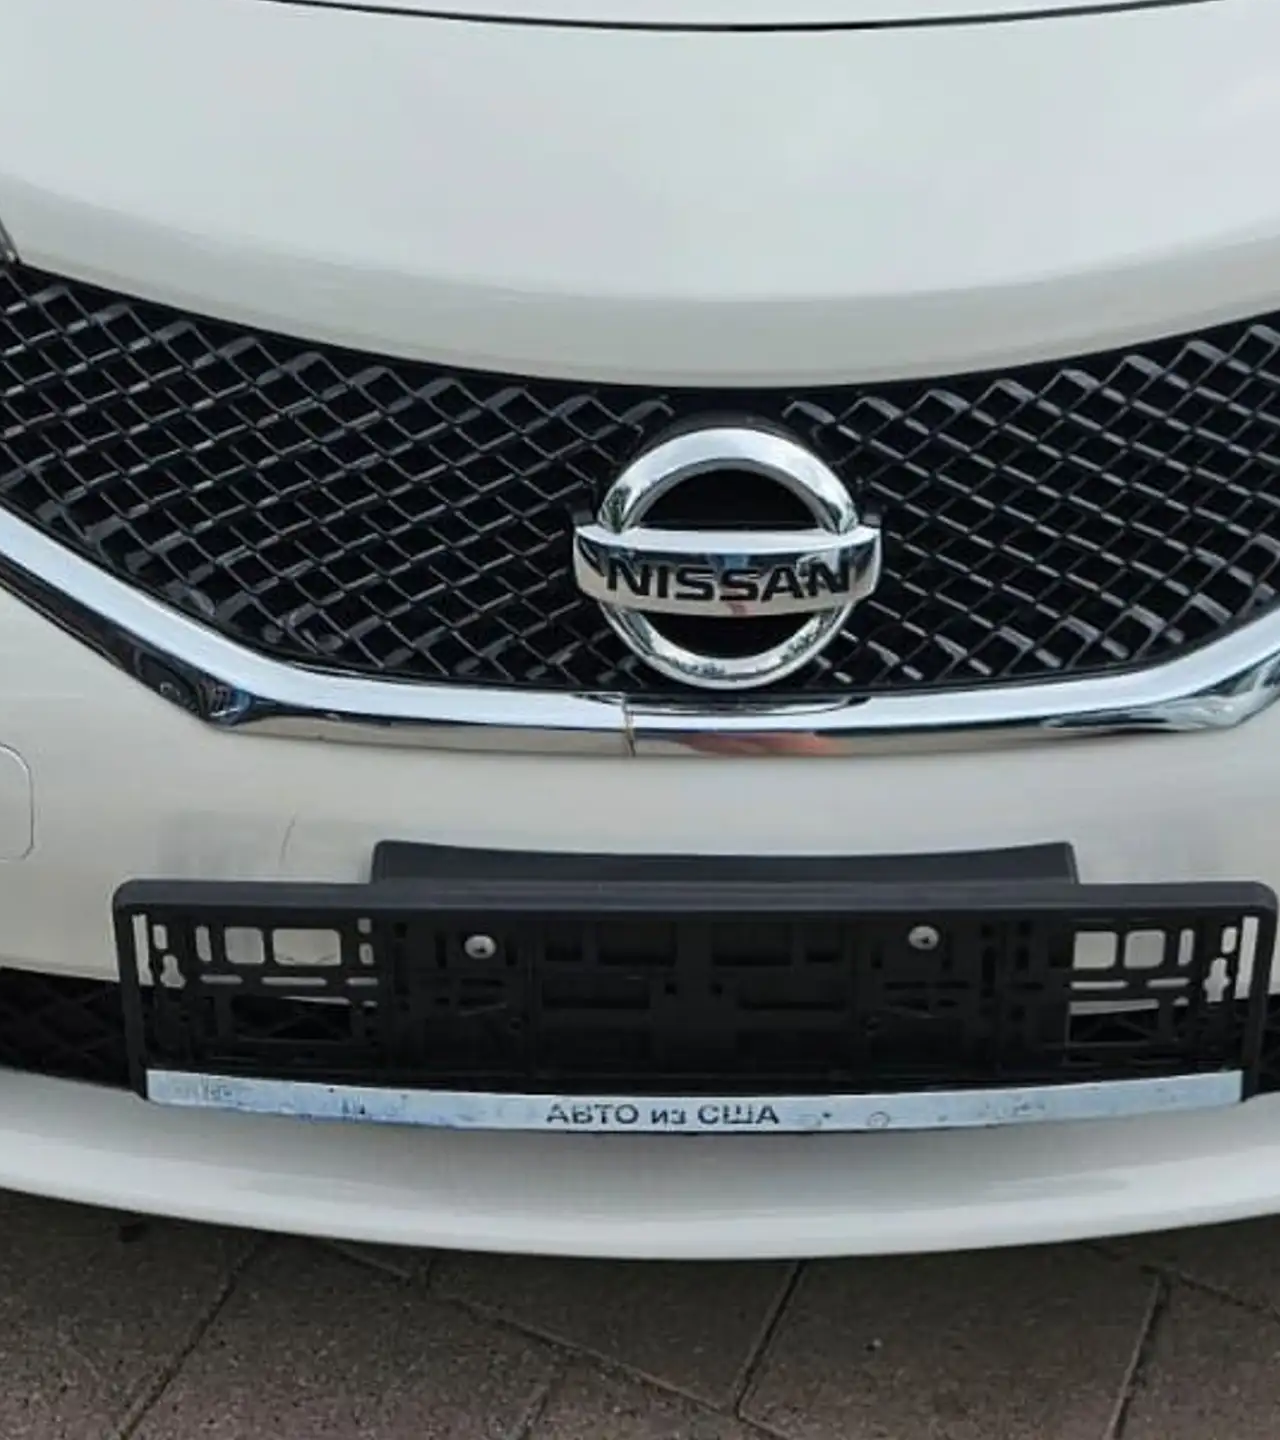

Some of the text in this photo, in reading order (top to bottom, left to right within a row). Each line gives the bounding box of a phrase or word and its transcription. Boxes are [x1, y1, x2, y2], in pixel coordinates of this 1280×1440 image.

[606, 556, 850, 602] NISSAN
[547, 1103, 780, 1125] АВТО из США
